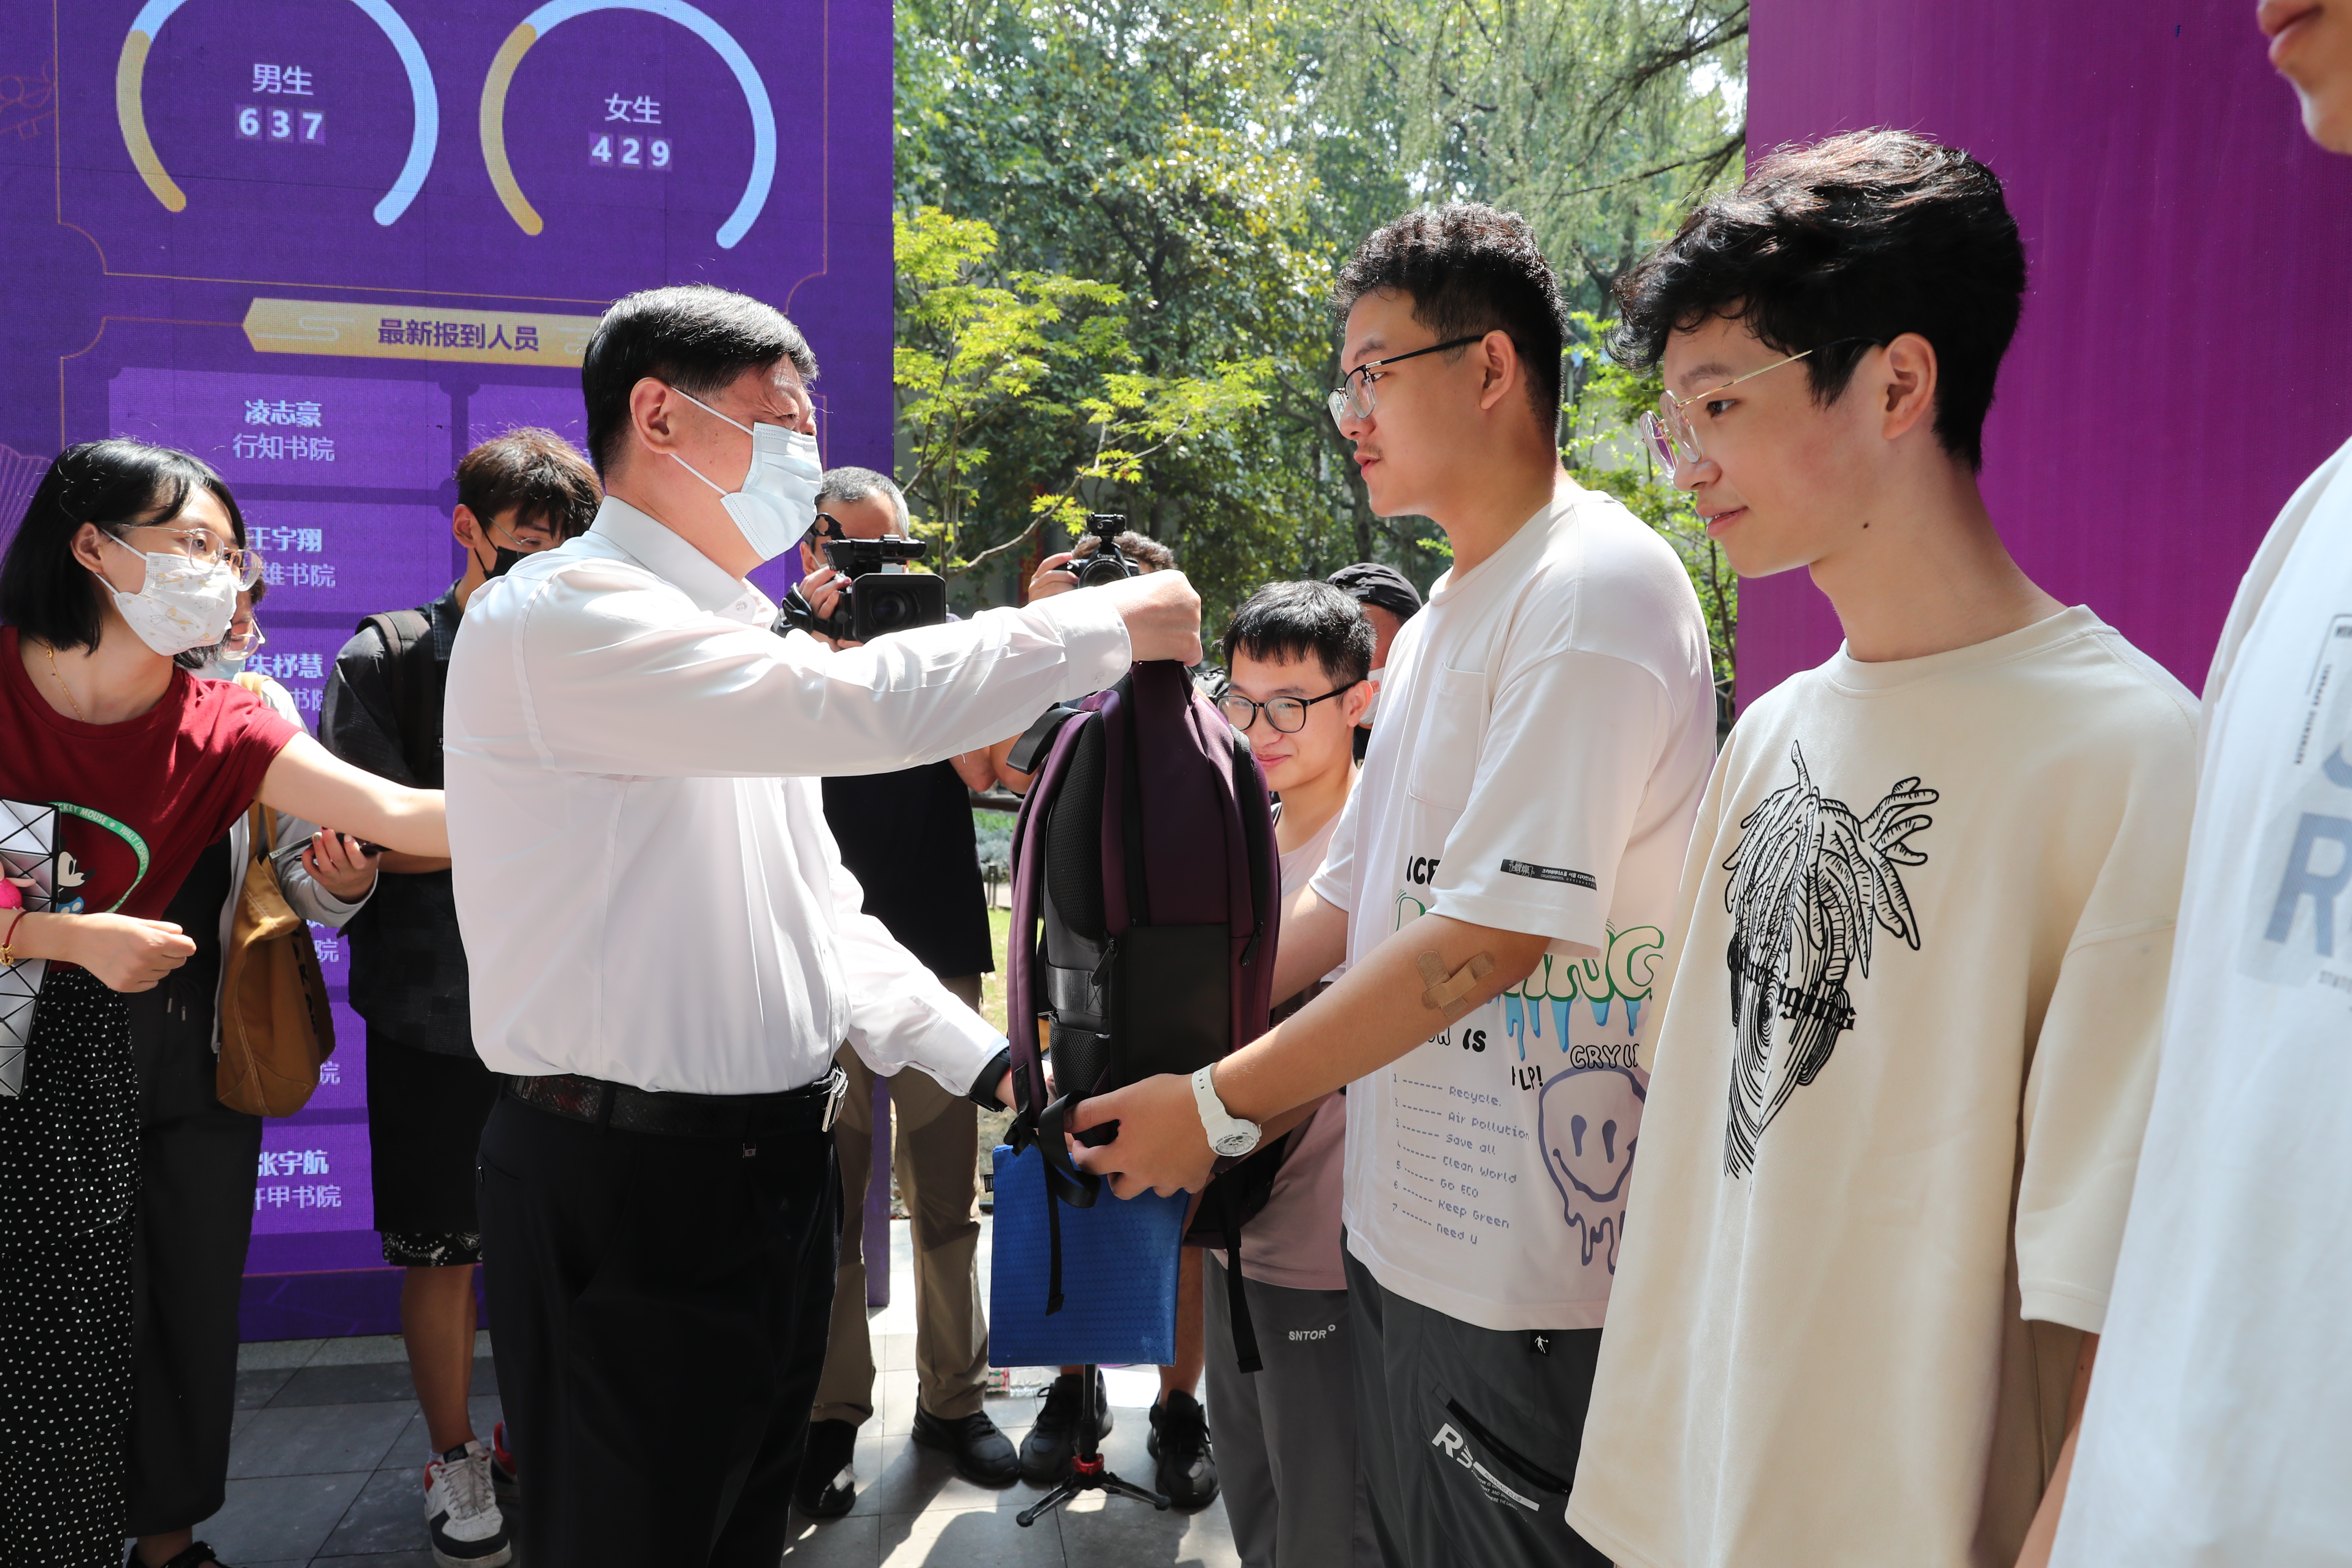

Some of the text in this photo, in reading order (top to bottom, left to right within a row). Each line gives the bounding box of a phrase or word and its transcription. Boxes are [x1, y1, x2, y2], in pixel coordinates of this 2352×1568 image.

[253, 64, 314, 95] 男生
[605, 92, 662, 124] 女生
[239, 107, 322, 140] 637
[591, 136, 670, 166] 429
[378, 318, 539, 352] 最新报到人员
[244, 399, 322, 427] 凌志豪
[233, 432, 335, 461] 行知书院
[261, 562, 336, 587] 雄书院
[80, 809, 107, 824] MOUSE
[119, 826, 139, 842] WALT
[135, 842, 147, 870] DISNEY'S
[1463, 1028, 1486, 1052] IS
[1449, 1086, 1502, 1106] Recycle.
[1449, 1112, 1465, 1124] Air
[1446, 1134, 1473, 1149] Save
[1479, 1144, 1496, 1155] all
[258, 1149, 330, 1176] 张宇航
[1443, 1156, 1473, 1173] Clean
[1480, 1166, 1517, 1183] World
[1441, 1179, 1455, 1190] Go
[1461, 1184, 1479, 1198] ECO
[1439, 1199, 1467, 1218] Keep
[1473, 1210, 1509, 1228] Green
[1484, 1473, 1507, 1492] RUNNING
[1508, 1491, 1522, 1502] CLUB
